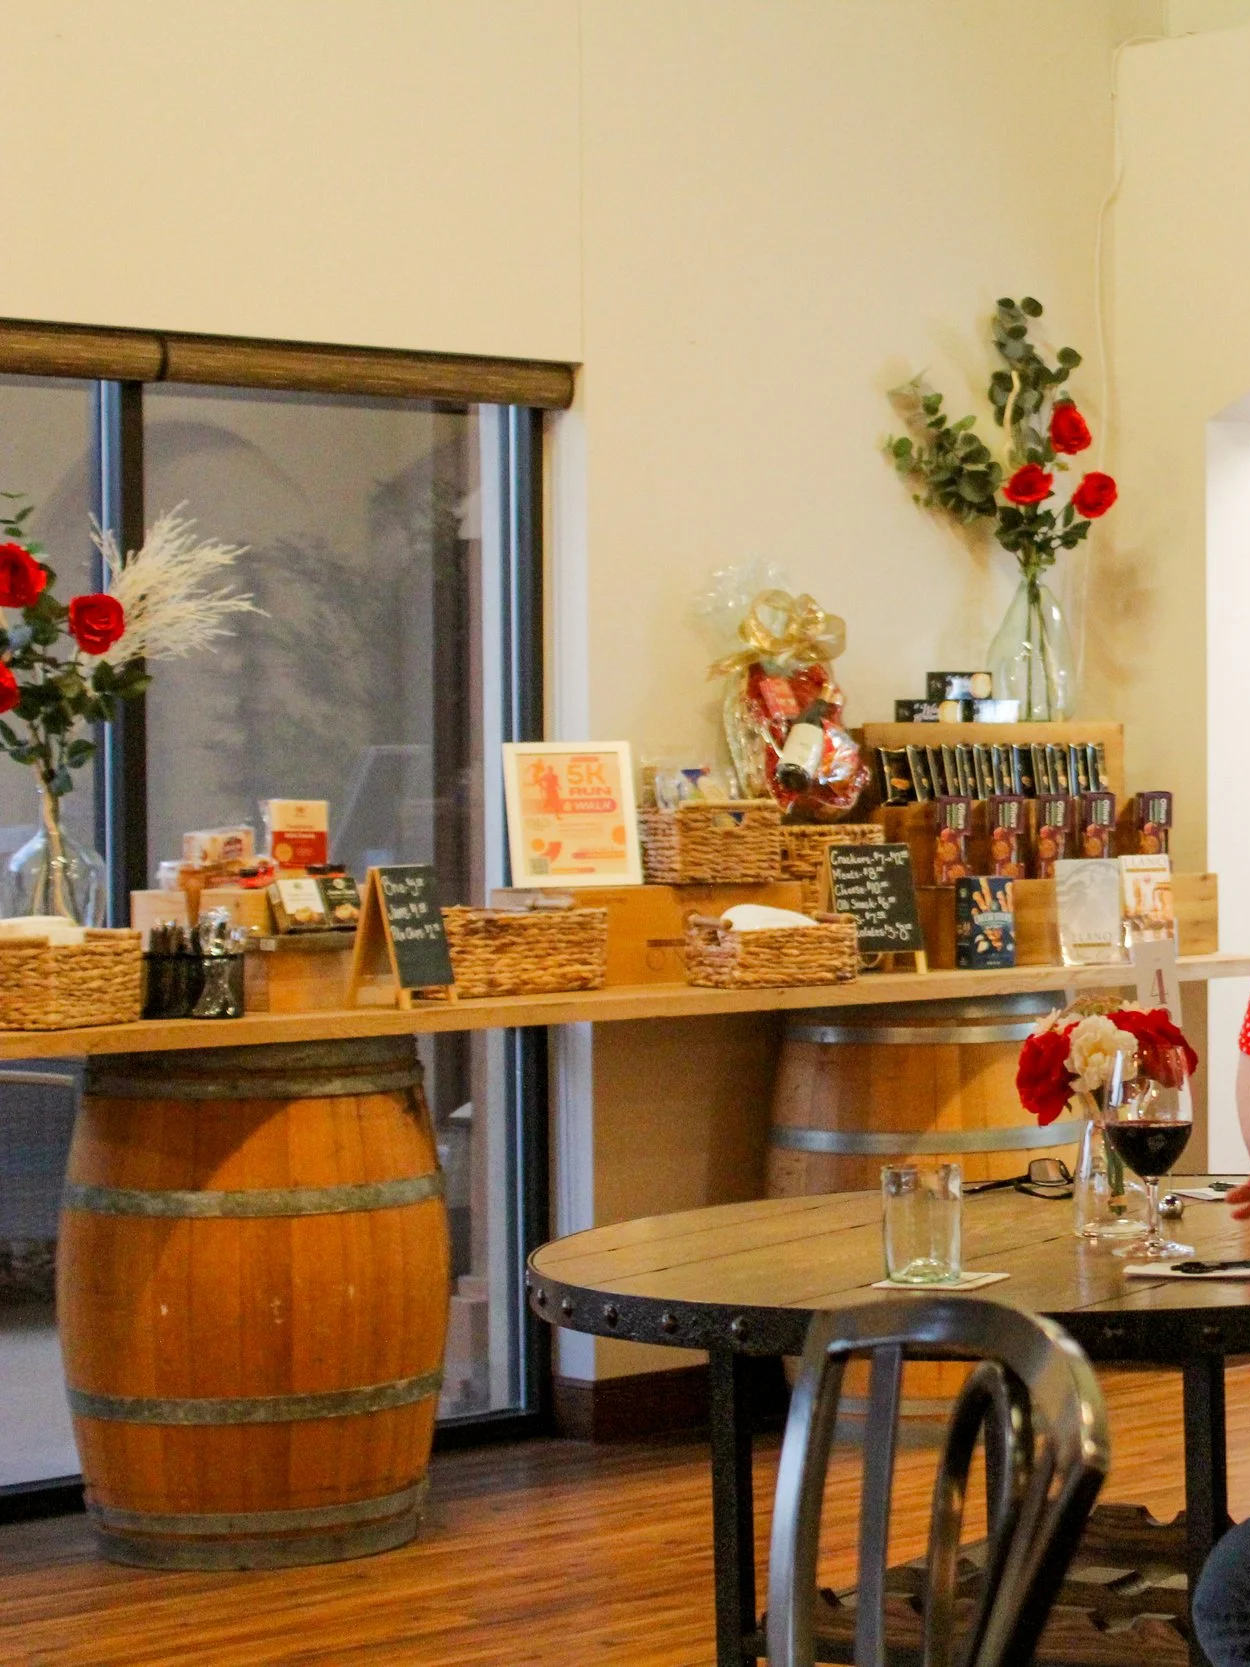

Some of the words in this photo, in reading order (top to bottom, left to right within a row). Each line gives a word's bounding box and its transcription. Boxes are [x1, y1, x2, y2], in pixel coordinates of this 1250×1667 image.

[567, 763, 605, 785] 5K
[568, 786, 612, 797] RUN
[1151, 968, 1169, 1005] 4
